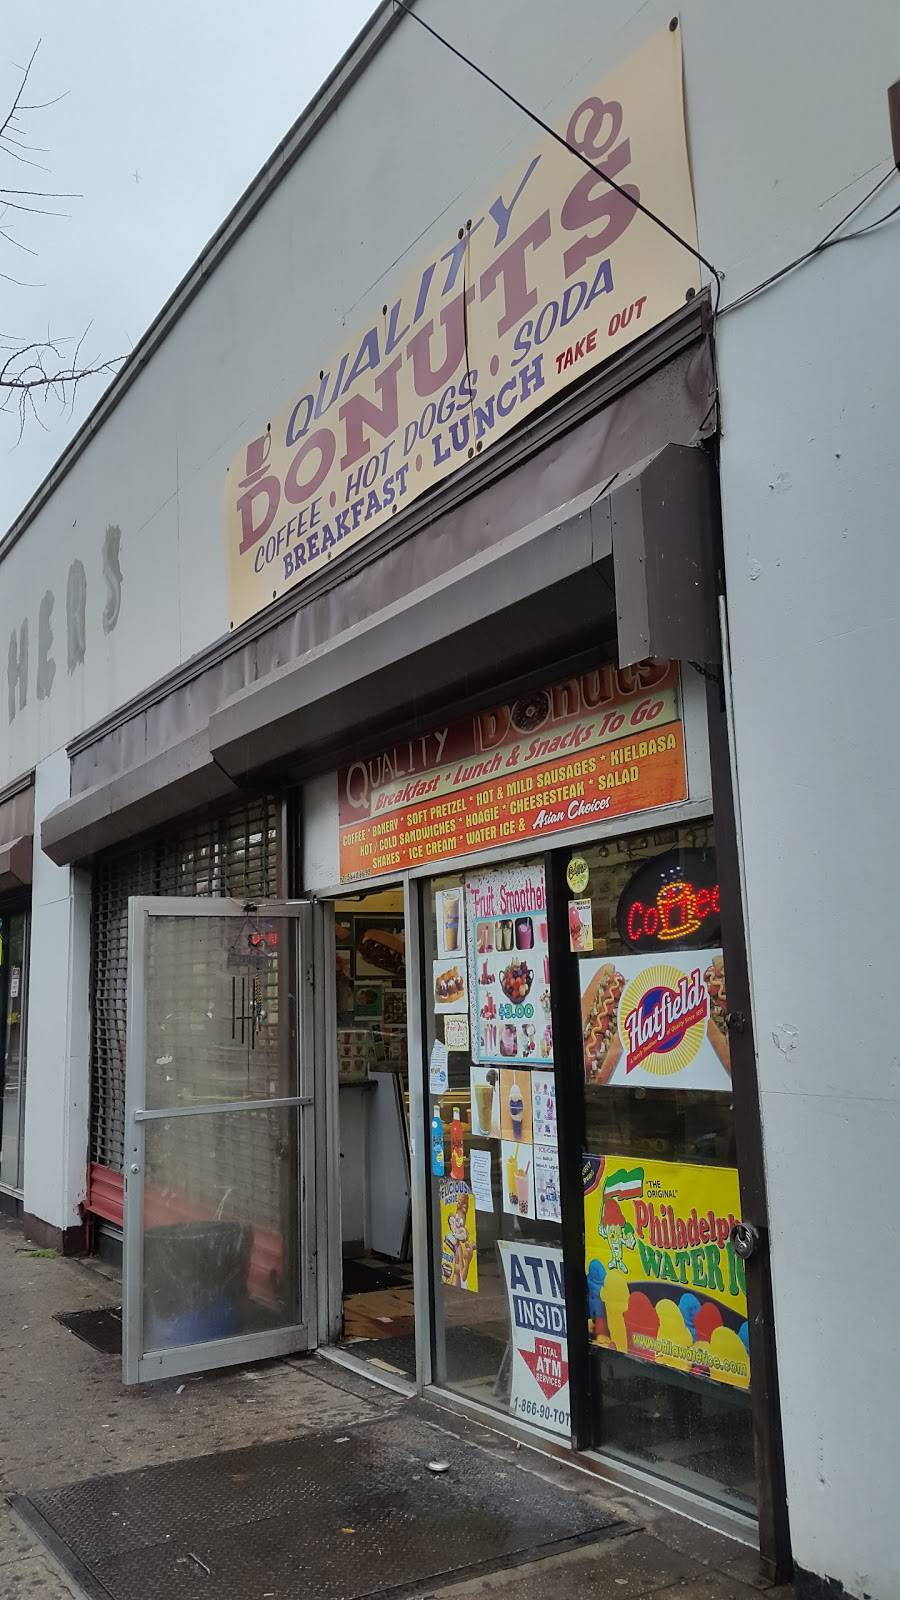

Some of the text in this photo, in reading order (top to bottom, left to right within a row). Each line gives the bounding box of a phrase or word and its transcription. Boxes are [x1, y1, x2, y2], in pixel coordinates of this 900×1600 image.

[286, 154, 541, 447] QUALITY
[236, 137, 641, 555] DONUTS
[254, 258, 615, 573] COFFEE HOT DOGS SODA
[283, 296, 647, 580] BREAKFAST LUNCH TAKE OUT
[342, 829, 367, 846] COFFEE
[372, 818, 399, 837] BAKERY
[406, 809, 428, 827] SOFT
[430, 798, 468, 820] PRETZEL
[476, 789, 494, 806] HOT
[506, 777, 533, 798] MILD
[537, 757, 597, 788] SAUSAGES
[610, 734, 677, 766] KIELBASA
[346, 727, 449, 809] QUALITY
[374, 699, 665, 811] Breakfast Lunch & Snacks To Go
[360, 843, 373, 857] HOT
[379, 834, 397, 850] COLD
[399, 818, 456, 845] SANDWICHES
[465, 806, 500, 828] HOAGIE
[509, 781, 585, 815] CHEESESTEAK
[598, 766, 639, 790] SALAD
[372, 796, 612, 869] SHAKES ICE CREAM WATER ICE & Asian Choices
[499, 1002, 534, 1021] $3.00
[626, 971, 705, 1053] Hatfield
[637, 1239, 725, 1292] WATER
[517, 1299, 567, 1334] INSID
[539, 1345, 558, 1359] TOTAL
[535, 1373, 562, 1388] SERVICES
[536, 1356, 562, 1378] ATM
